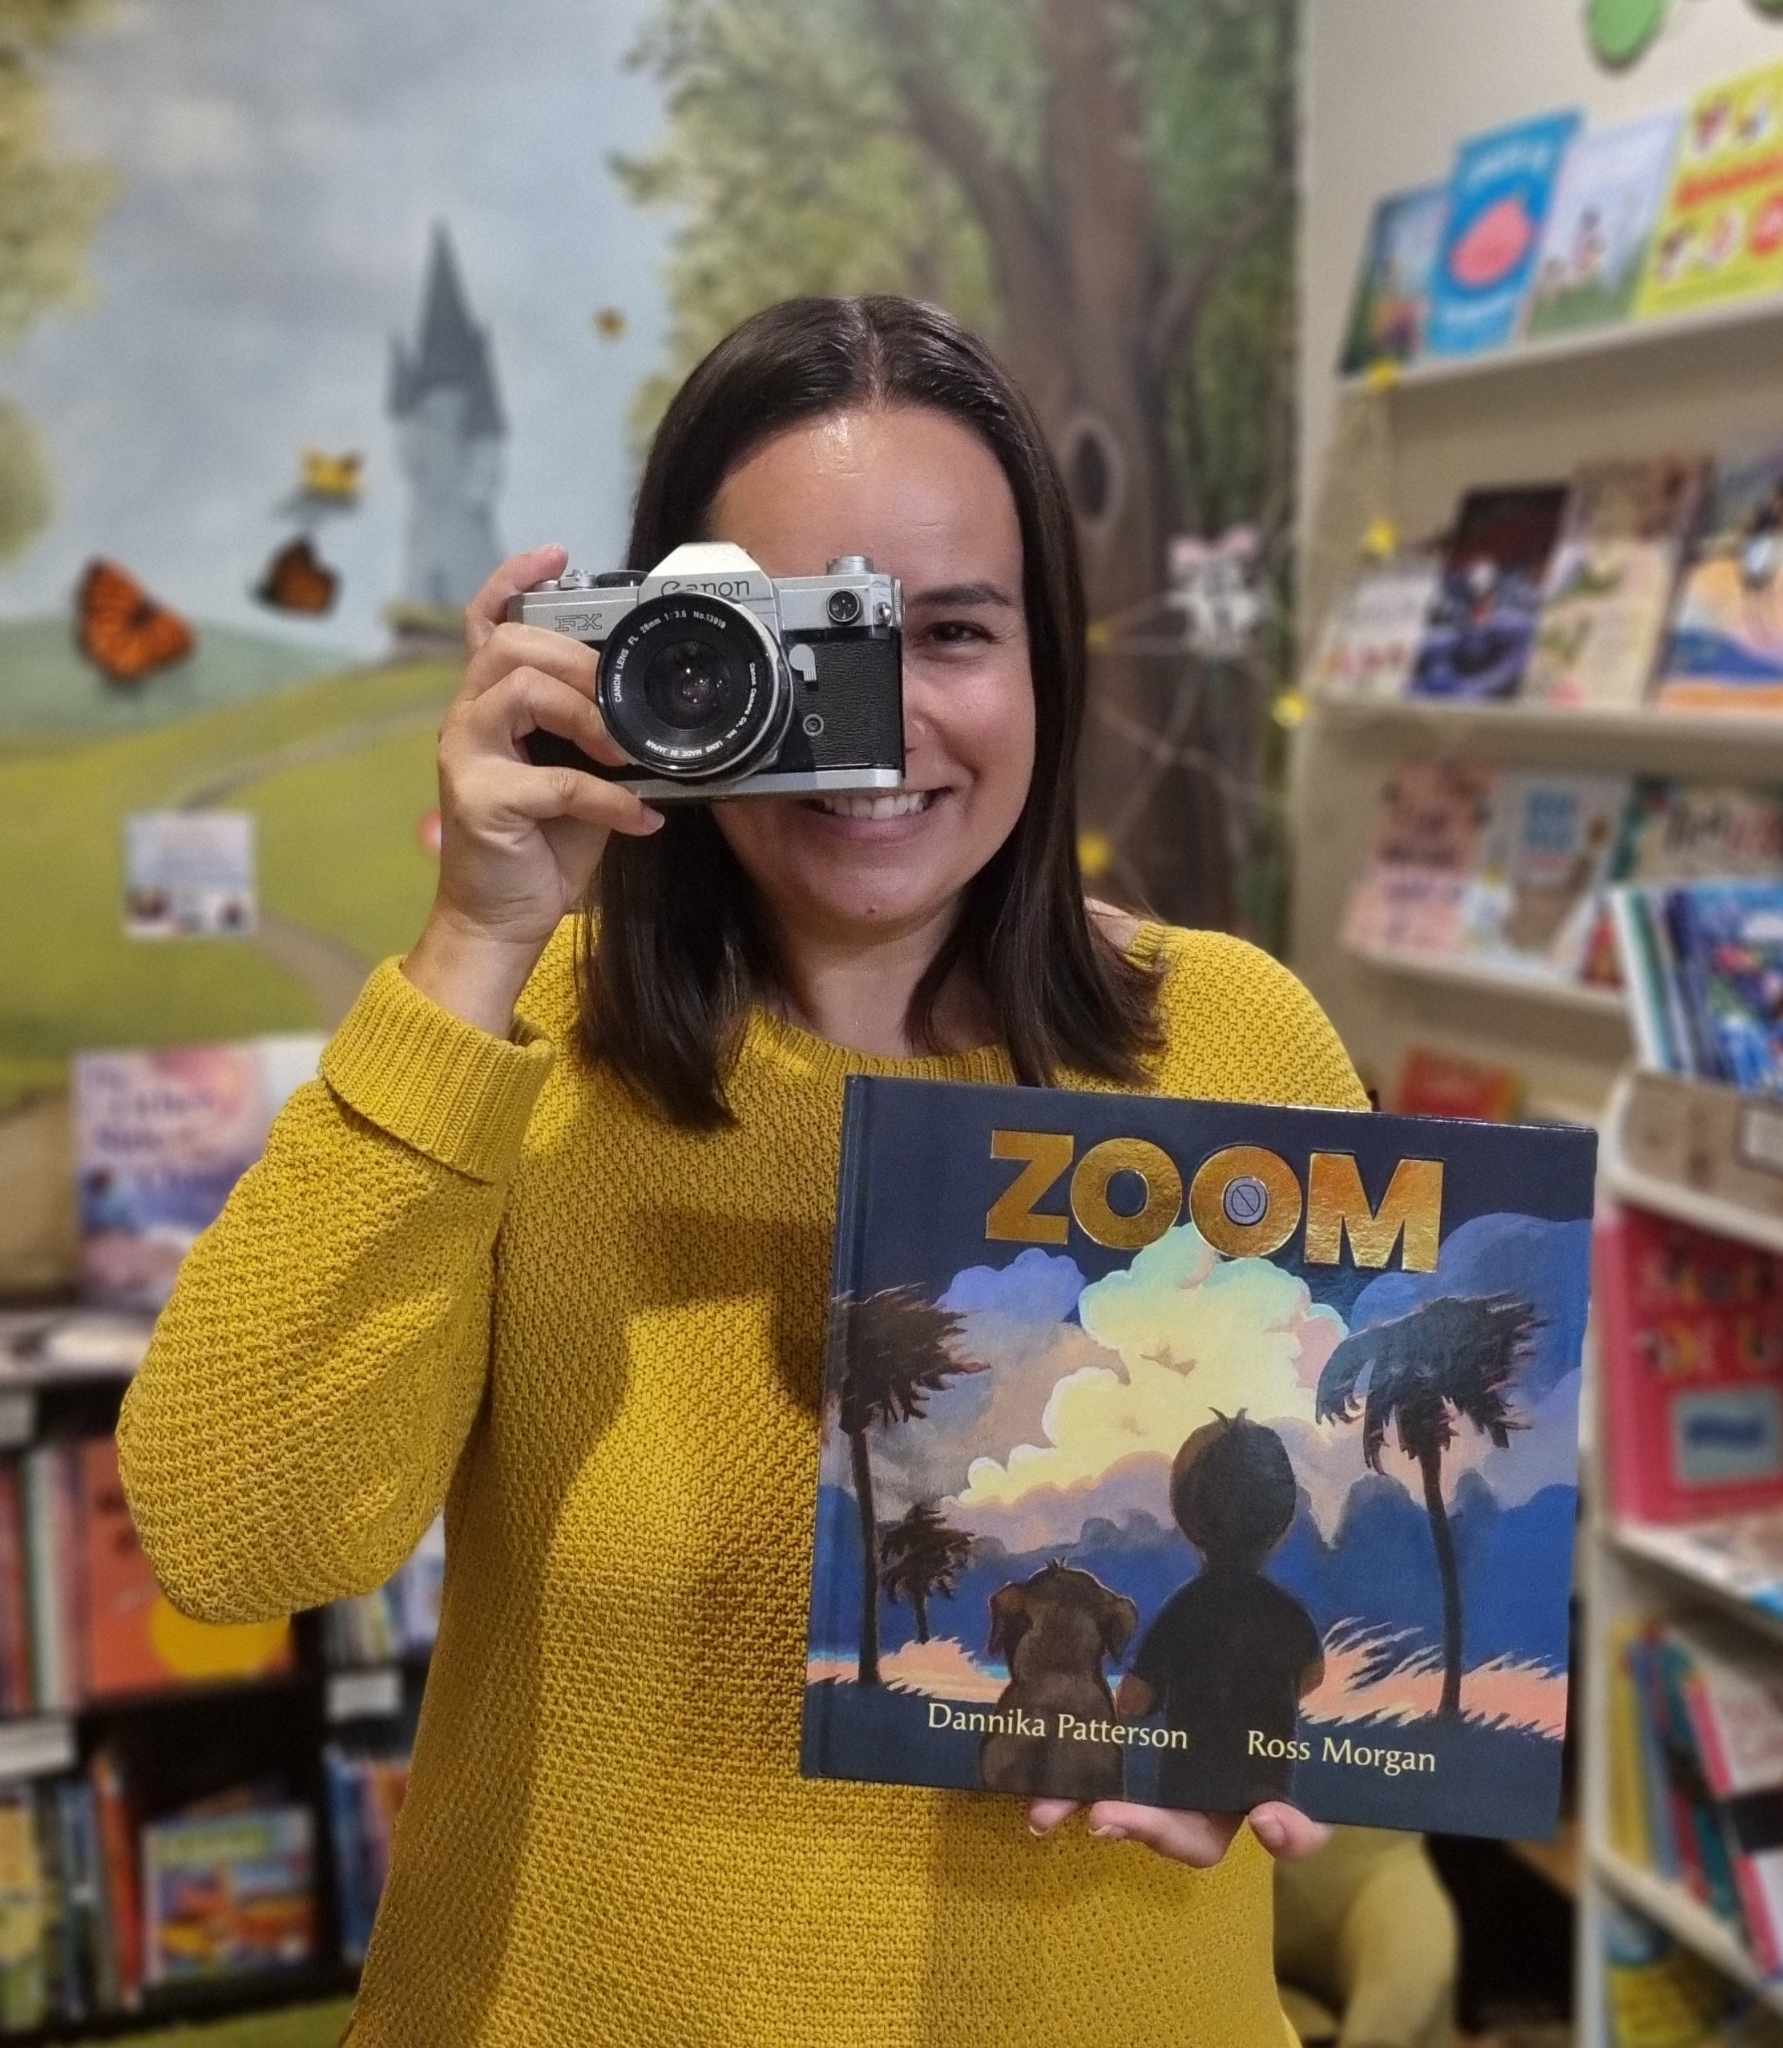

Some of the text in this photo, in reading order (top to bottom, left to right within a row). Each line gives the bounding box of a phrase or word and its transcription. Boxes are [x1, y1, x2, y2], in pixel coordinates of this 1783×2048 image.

[554, 613, 602, 632] FX
[613, 673, 622, 702] CANON
[984, 1129, 1445, 1274] ZOOM
[928, 1702, 1188, 1750] Dannika Patterson
[1247, 1730, 1436, 1776] Ross Morgan
